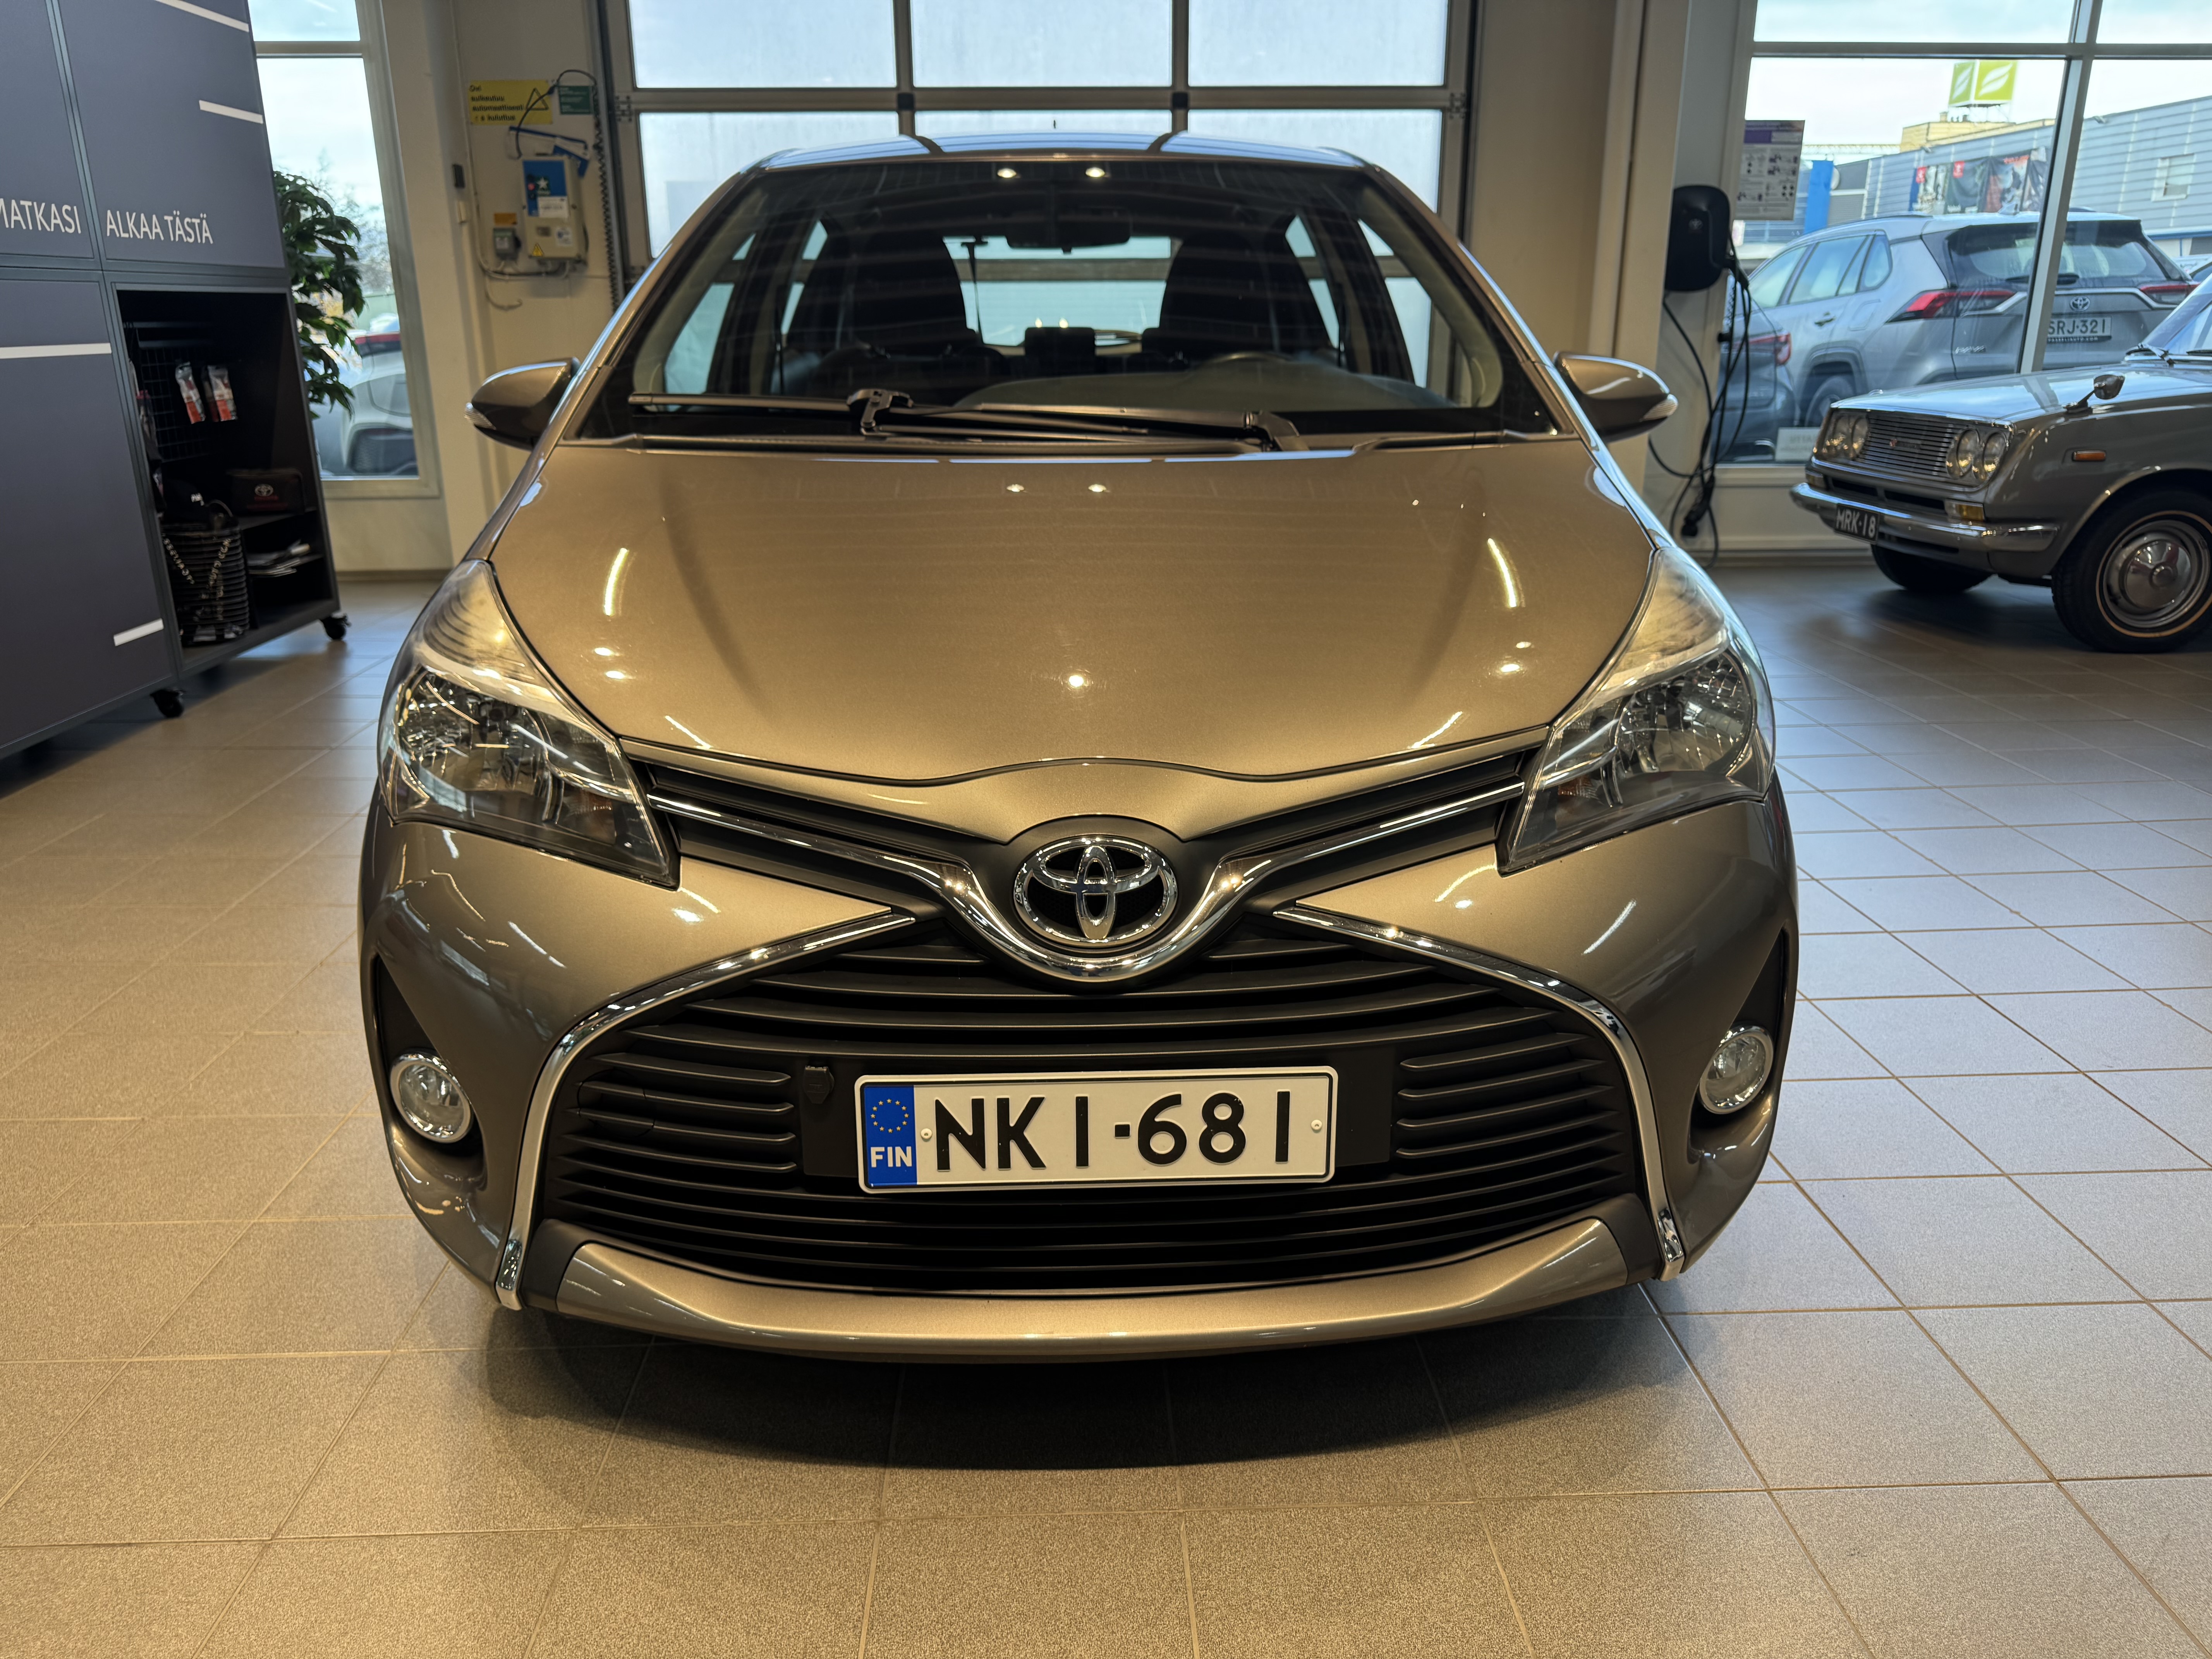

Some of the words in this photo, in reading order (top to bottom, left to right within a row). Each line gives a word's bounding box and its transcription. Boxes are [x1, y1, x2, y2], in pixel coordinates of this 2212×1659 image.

[107, 210, 164, 240] ALKAA
[164, 210, 213, 244] TÄSTÄ
[1836, 508, 1876, 538] MRK-18
[934, 1090, 1291, 1172] NKI-681
[871, 1146, 912, 1168] FIN
